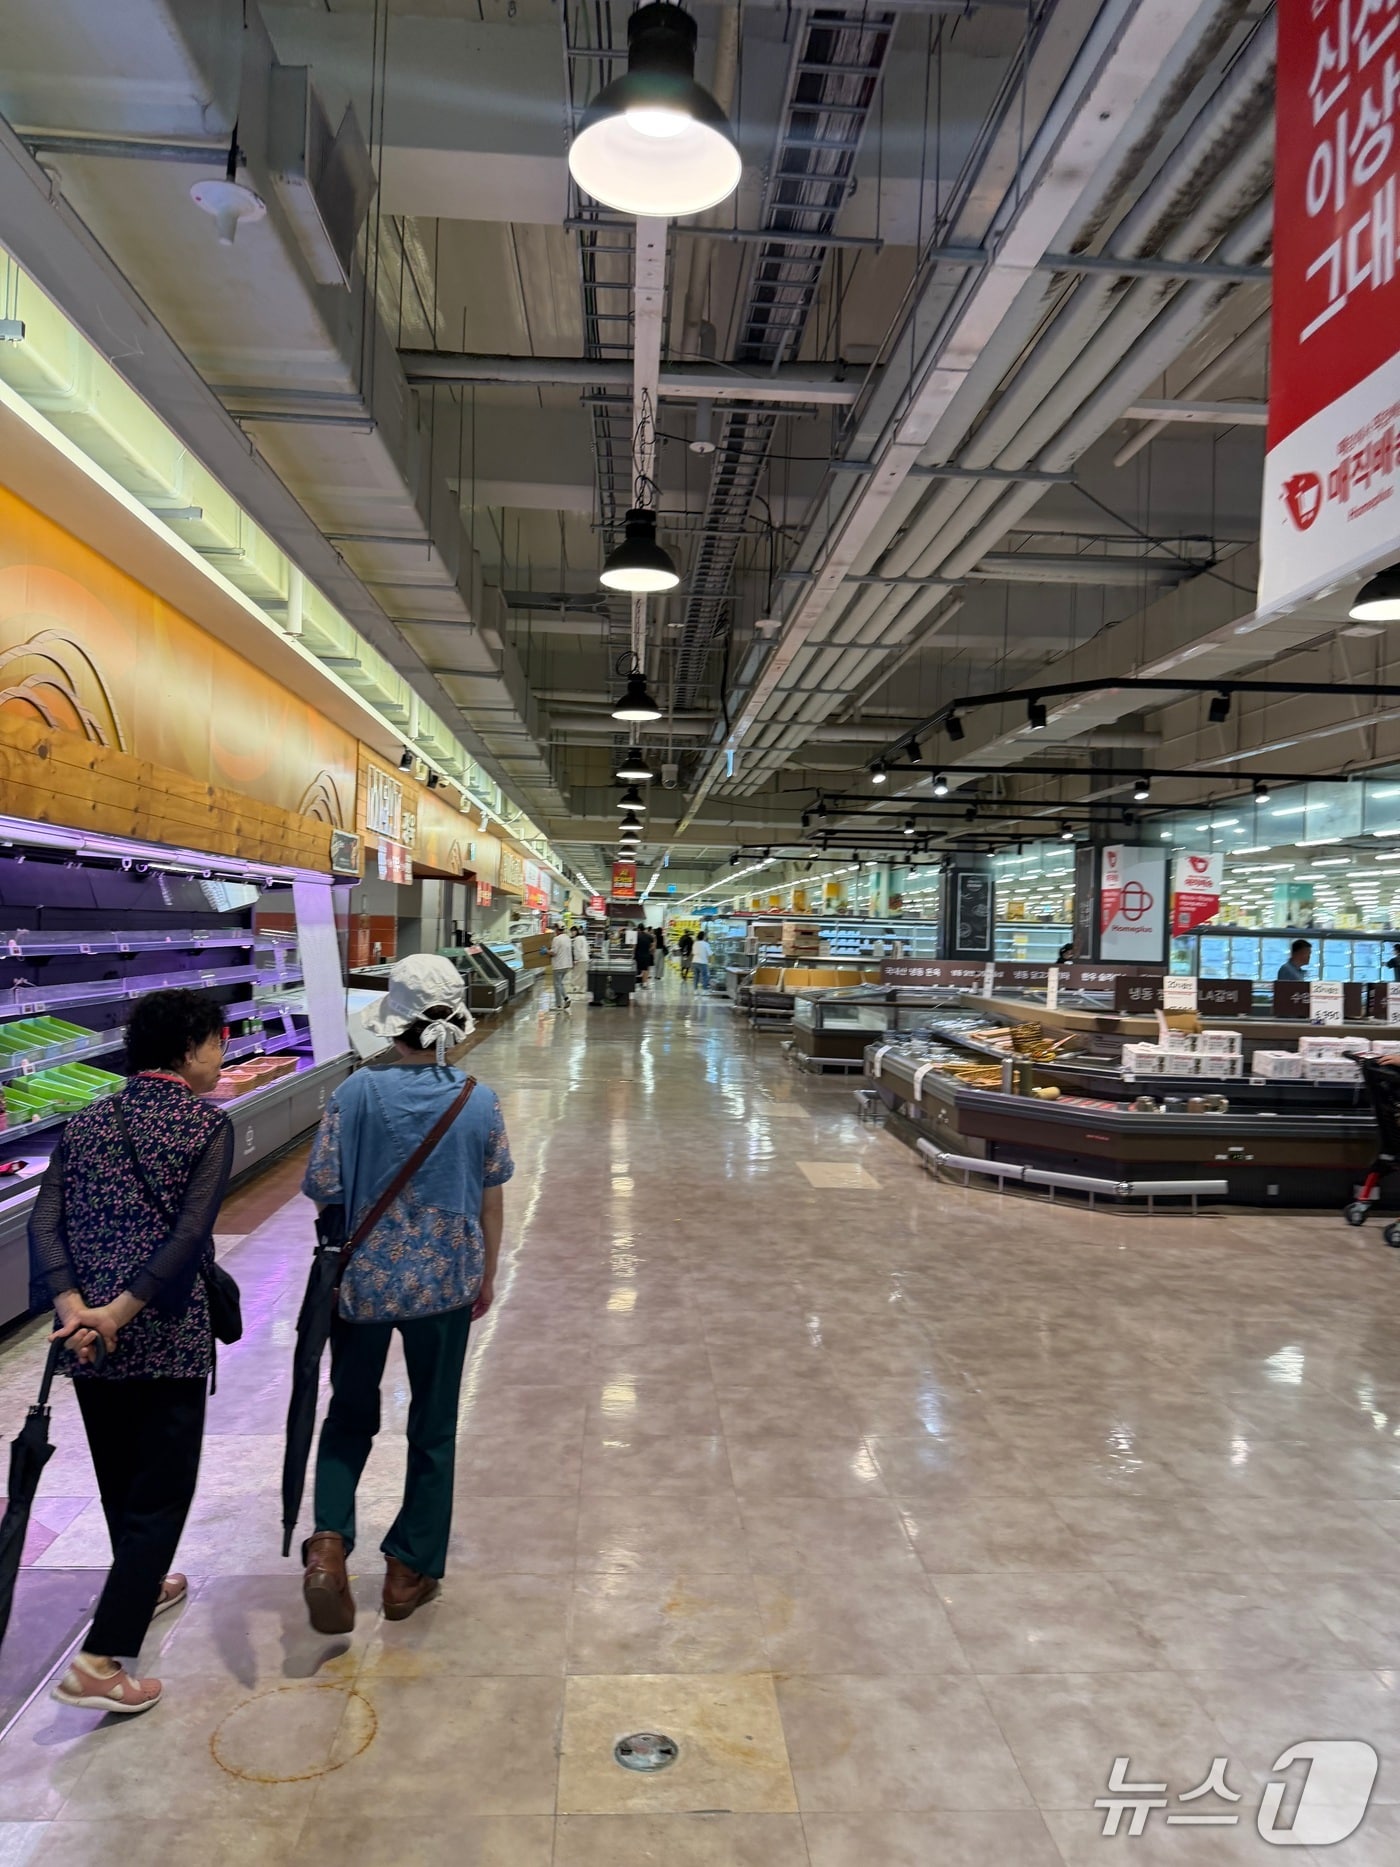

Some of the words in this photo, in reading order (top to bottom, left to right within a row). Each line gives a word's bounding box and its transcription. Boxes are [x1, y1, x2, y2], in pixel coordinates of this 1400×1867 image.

[1305, 54, 1400, 218] 이상
[1299, 173, 1400, 345] 그대
[1328, 424, 1400, 504] 매직배
[1112, 925, 1152, 934] Homeplus
[1128, 987, 1154, 1001] 냉동
[1198, 989, 1239, 1003] LA갈비
